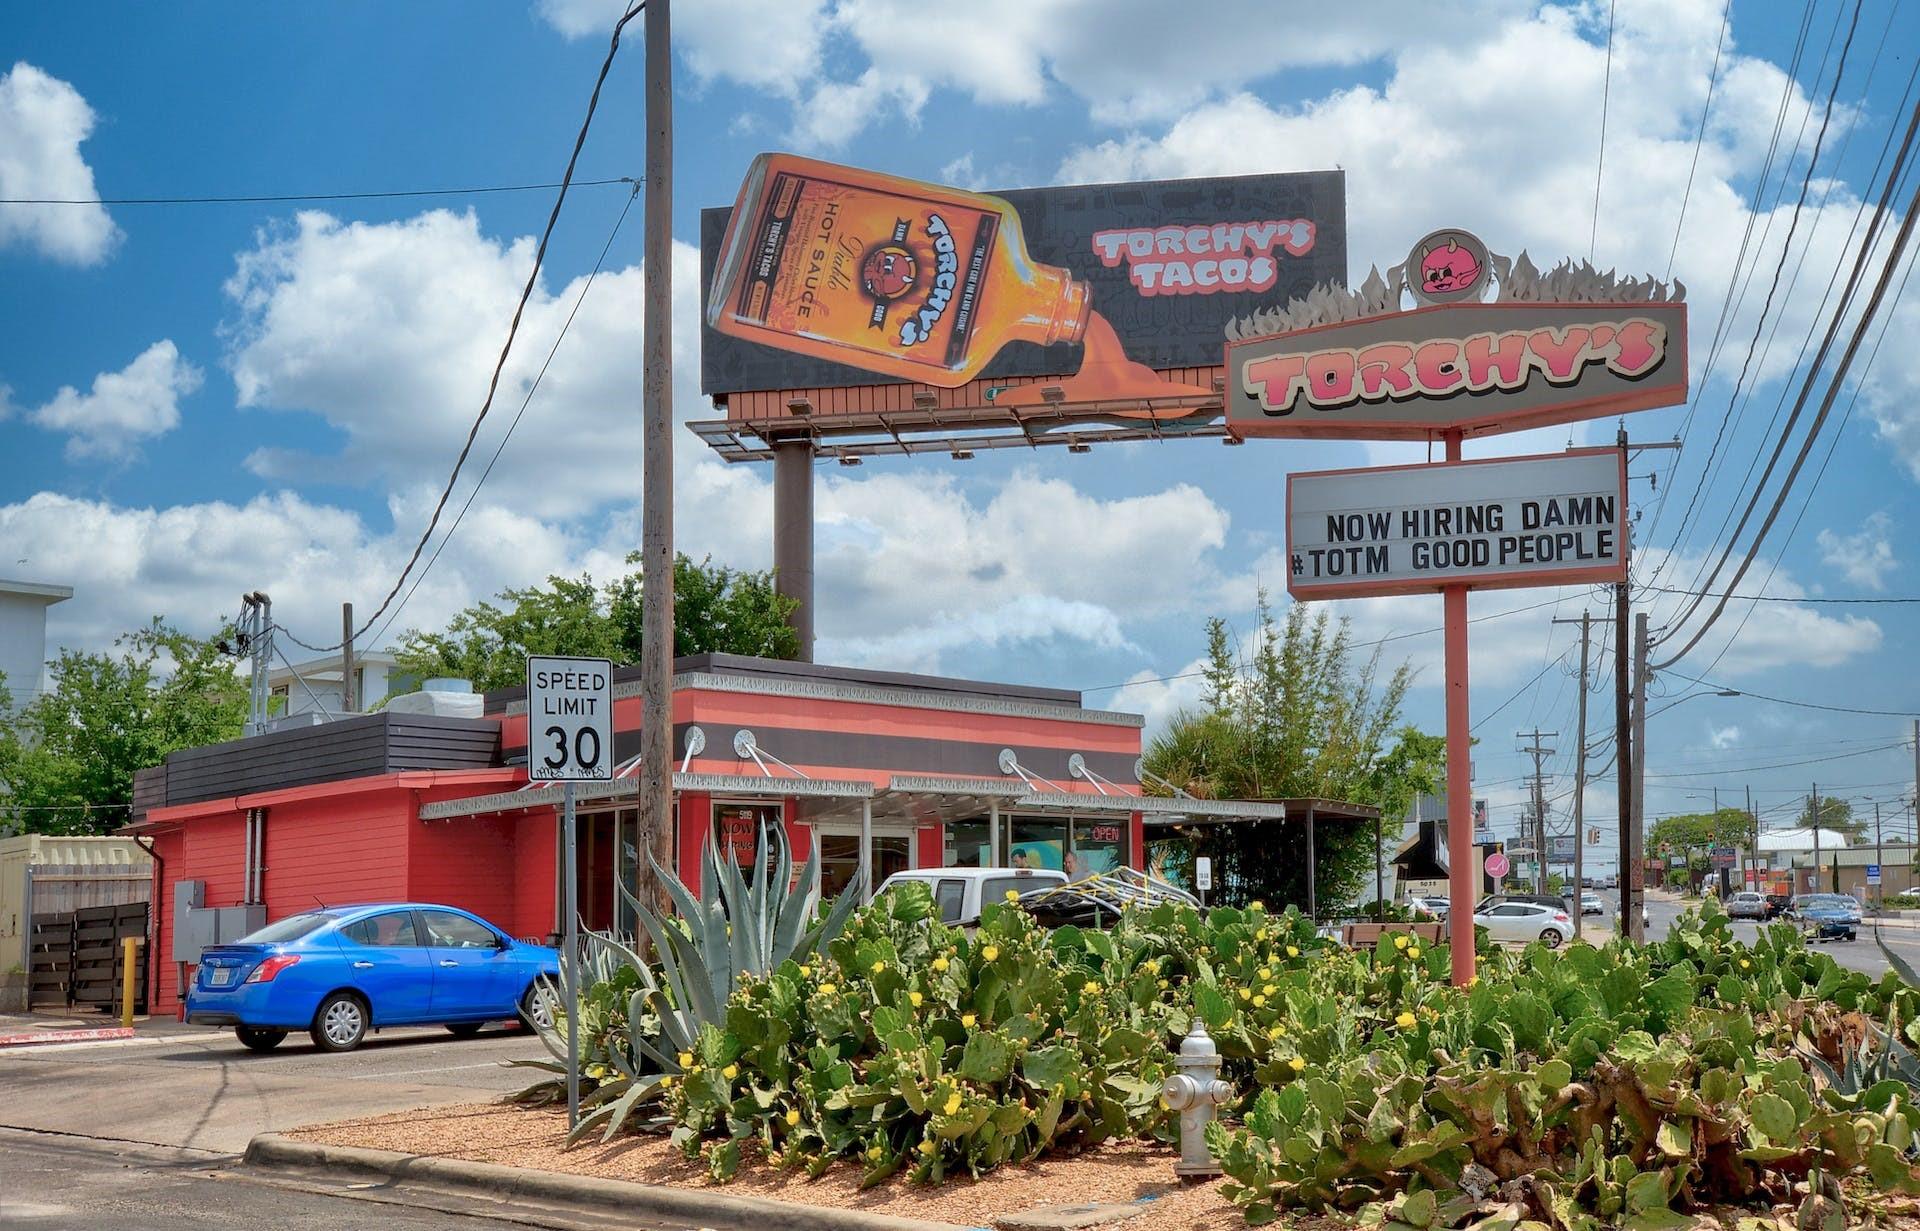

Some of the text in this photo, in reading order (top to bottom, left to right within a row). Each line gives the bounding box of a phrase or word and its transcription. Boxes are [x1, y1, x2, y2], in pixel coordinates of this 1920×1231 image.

[818, 203, 839, 244] HOT
[1095, 220, 1312, 260] TORCHY'S
[828, 231, 865, 291] Diablo
[900, 214, 958, 346] TORCHY'S
[1132, 256, 1275, 289] TACOS
[797, 249, 825, 318] SAUCE
[1245, 318, 1666, 412] TORCHY'S
[1327, 495, 1614, 543] NOW HIRING DAMN
[1412, 539, 1490, 570] GOOD
[1500, 529, 1614, 564] PEOPLE
[536, 672, 605, 692] SPEED
[544, 697, 597, 716] LIMIT
[544, 726, 600, 769] 30
[1093, 826, 1120, 841] OPEN
